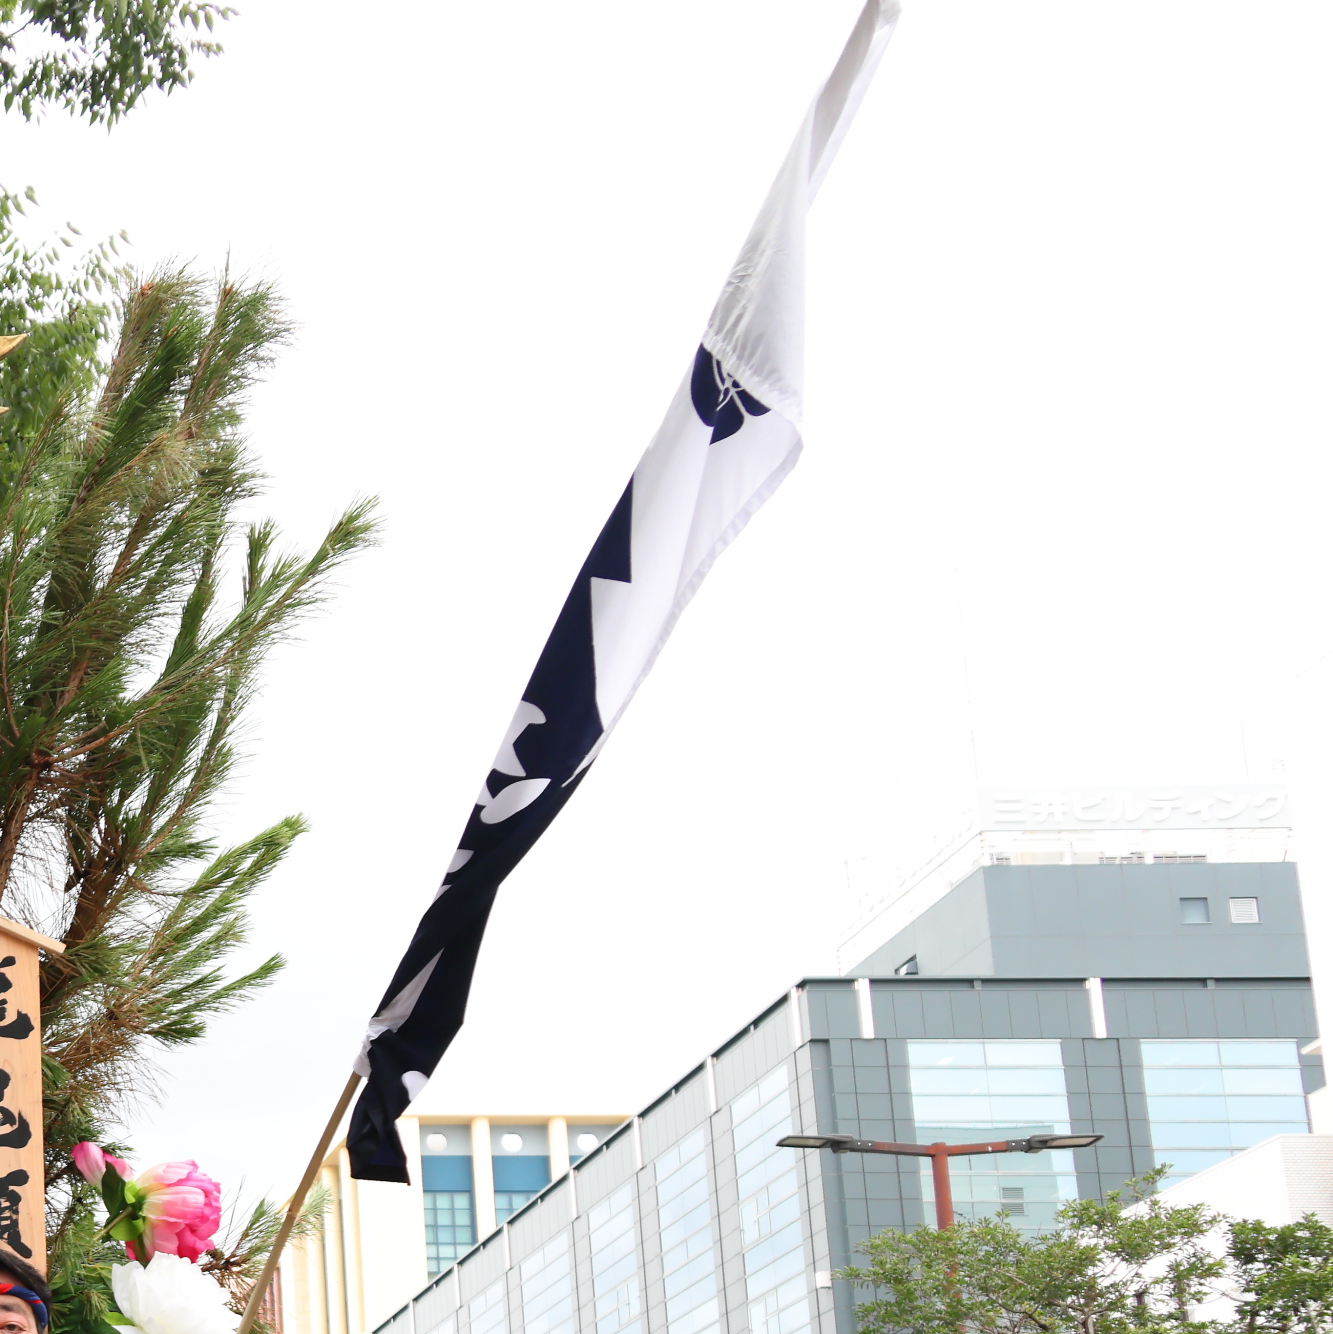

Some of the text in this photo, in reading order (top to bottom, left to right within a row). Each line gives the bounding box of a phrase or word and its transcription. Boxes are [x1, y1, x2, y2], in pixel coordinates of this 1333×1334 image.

[992, 786, 1291, 824] 三井ビルディング
